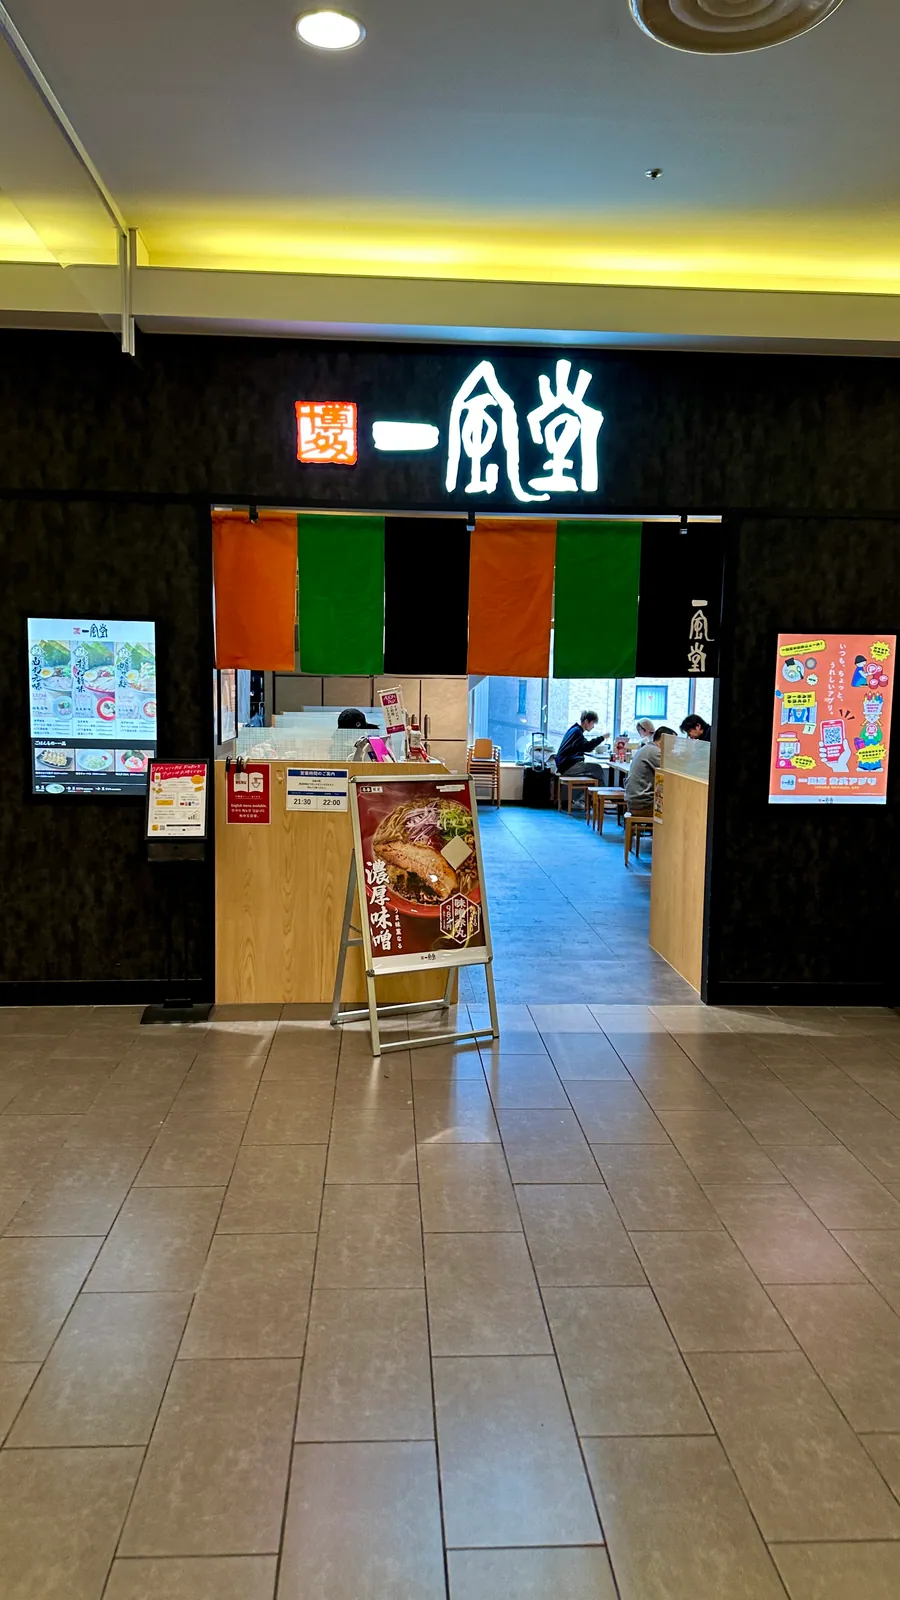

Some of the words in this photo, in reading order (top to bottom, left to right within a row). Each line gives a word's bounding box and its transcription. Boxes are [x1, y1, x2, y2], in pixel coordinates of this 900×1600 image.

[371, 359, 604, 501] 一風堂
[688, 599, 714, 672] 一風堂
[365, 860, 393, 951] 濃厚味噌
